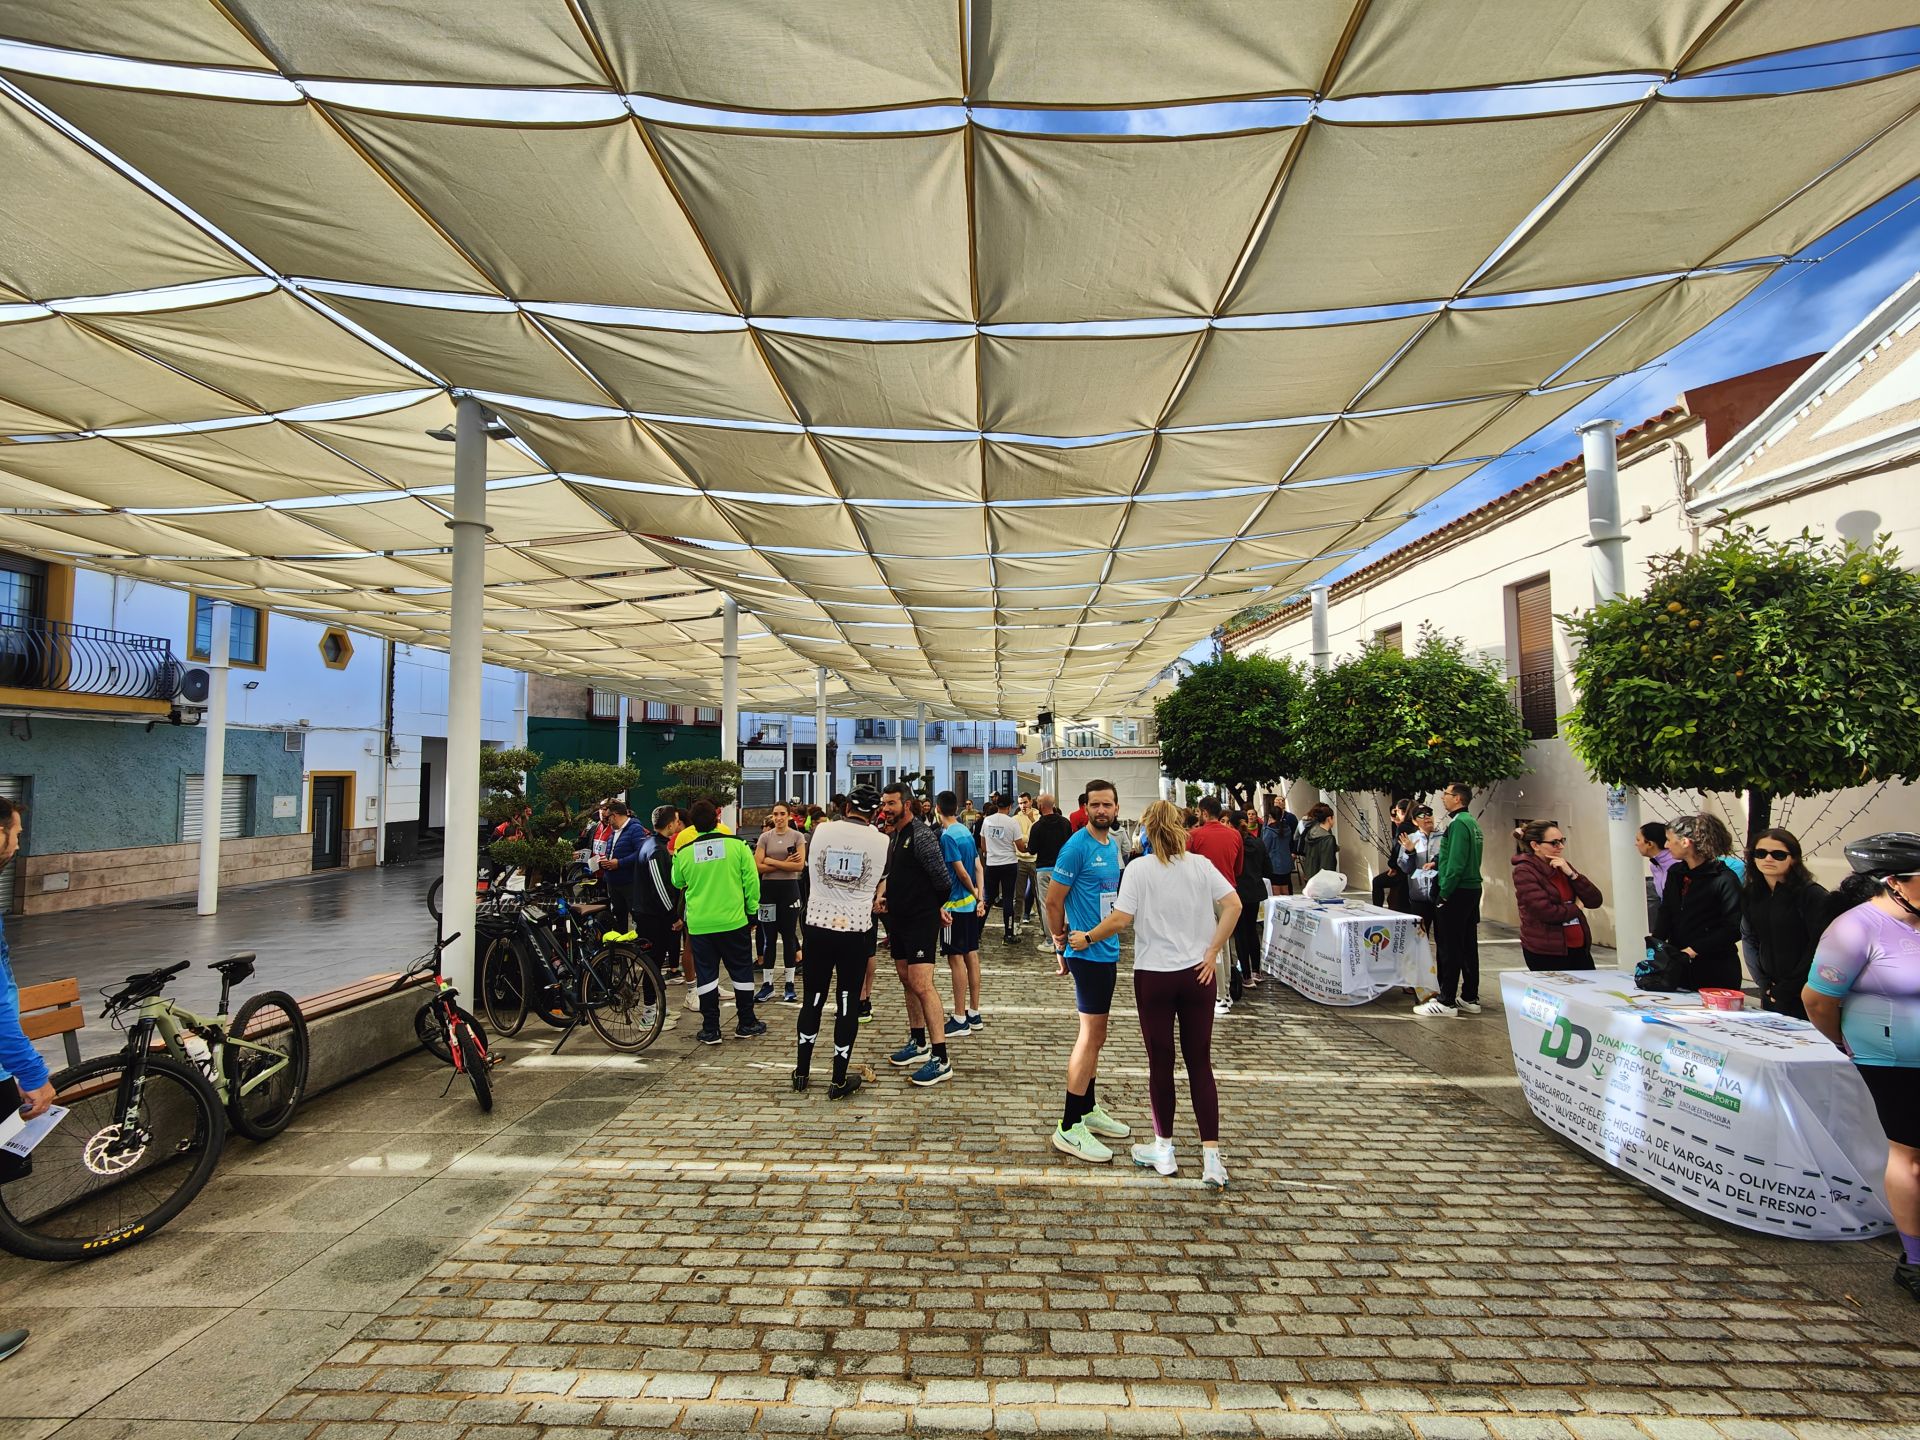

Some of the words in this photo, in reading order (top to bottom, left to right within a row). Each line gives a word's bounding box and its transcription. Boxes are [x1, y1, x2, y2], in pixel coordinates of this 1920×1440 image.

[1062, 748, 1114, 757] BOCADILLOS
[706, 845, 713, 856] 6
[839, 857, 849, 870] 11
[527, 933, 550, 969] SCOTT
[1591, 1046, 1604, 1060] DE
[1596, 1033, 1664, 1065] DINAMIZACIÓ
[1682, 1061, 1698, 1078] 5€
[124, 1104, 139, 1128] FOX
[1696, 1107, 1731, 1126] EXTREMADURA
[1534, 1078, 1573, 1106] BARCARROTA
[1578, 1101, 1607, 1122] CHELES
[1613, 1118, 1653, 1145] HIGUERA
[1655, 1137, 1670, 1152] DE
[1673, 1144, 1724, 1176] VARGAS
[1739, 1172, 1817, 1201] OLIVENZA
[1554, 1103, 1586, 1128] VALVERDE
[1586, 1120, 1598, 1134] DE
[1598, 1126, 1638, 1155] LEGANÉS
[1646, 1151, 1721, 1193] VILLANUEVA
[1725, 1185, 1755, 1205] DEL
[1759, 1195, 1818, 1218] FRESNO
[82, 1224, 145, 1250] MAXXIS
